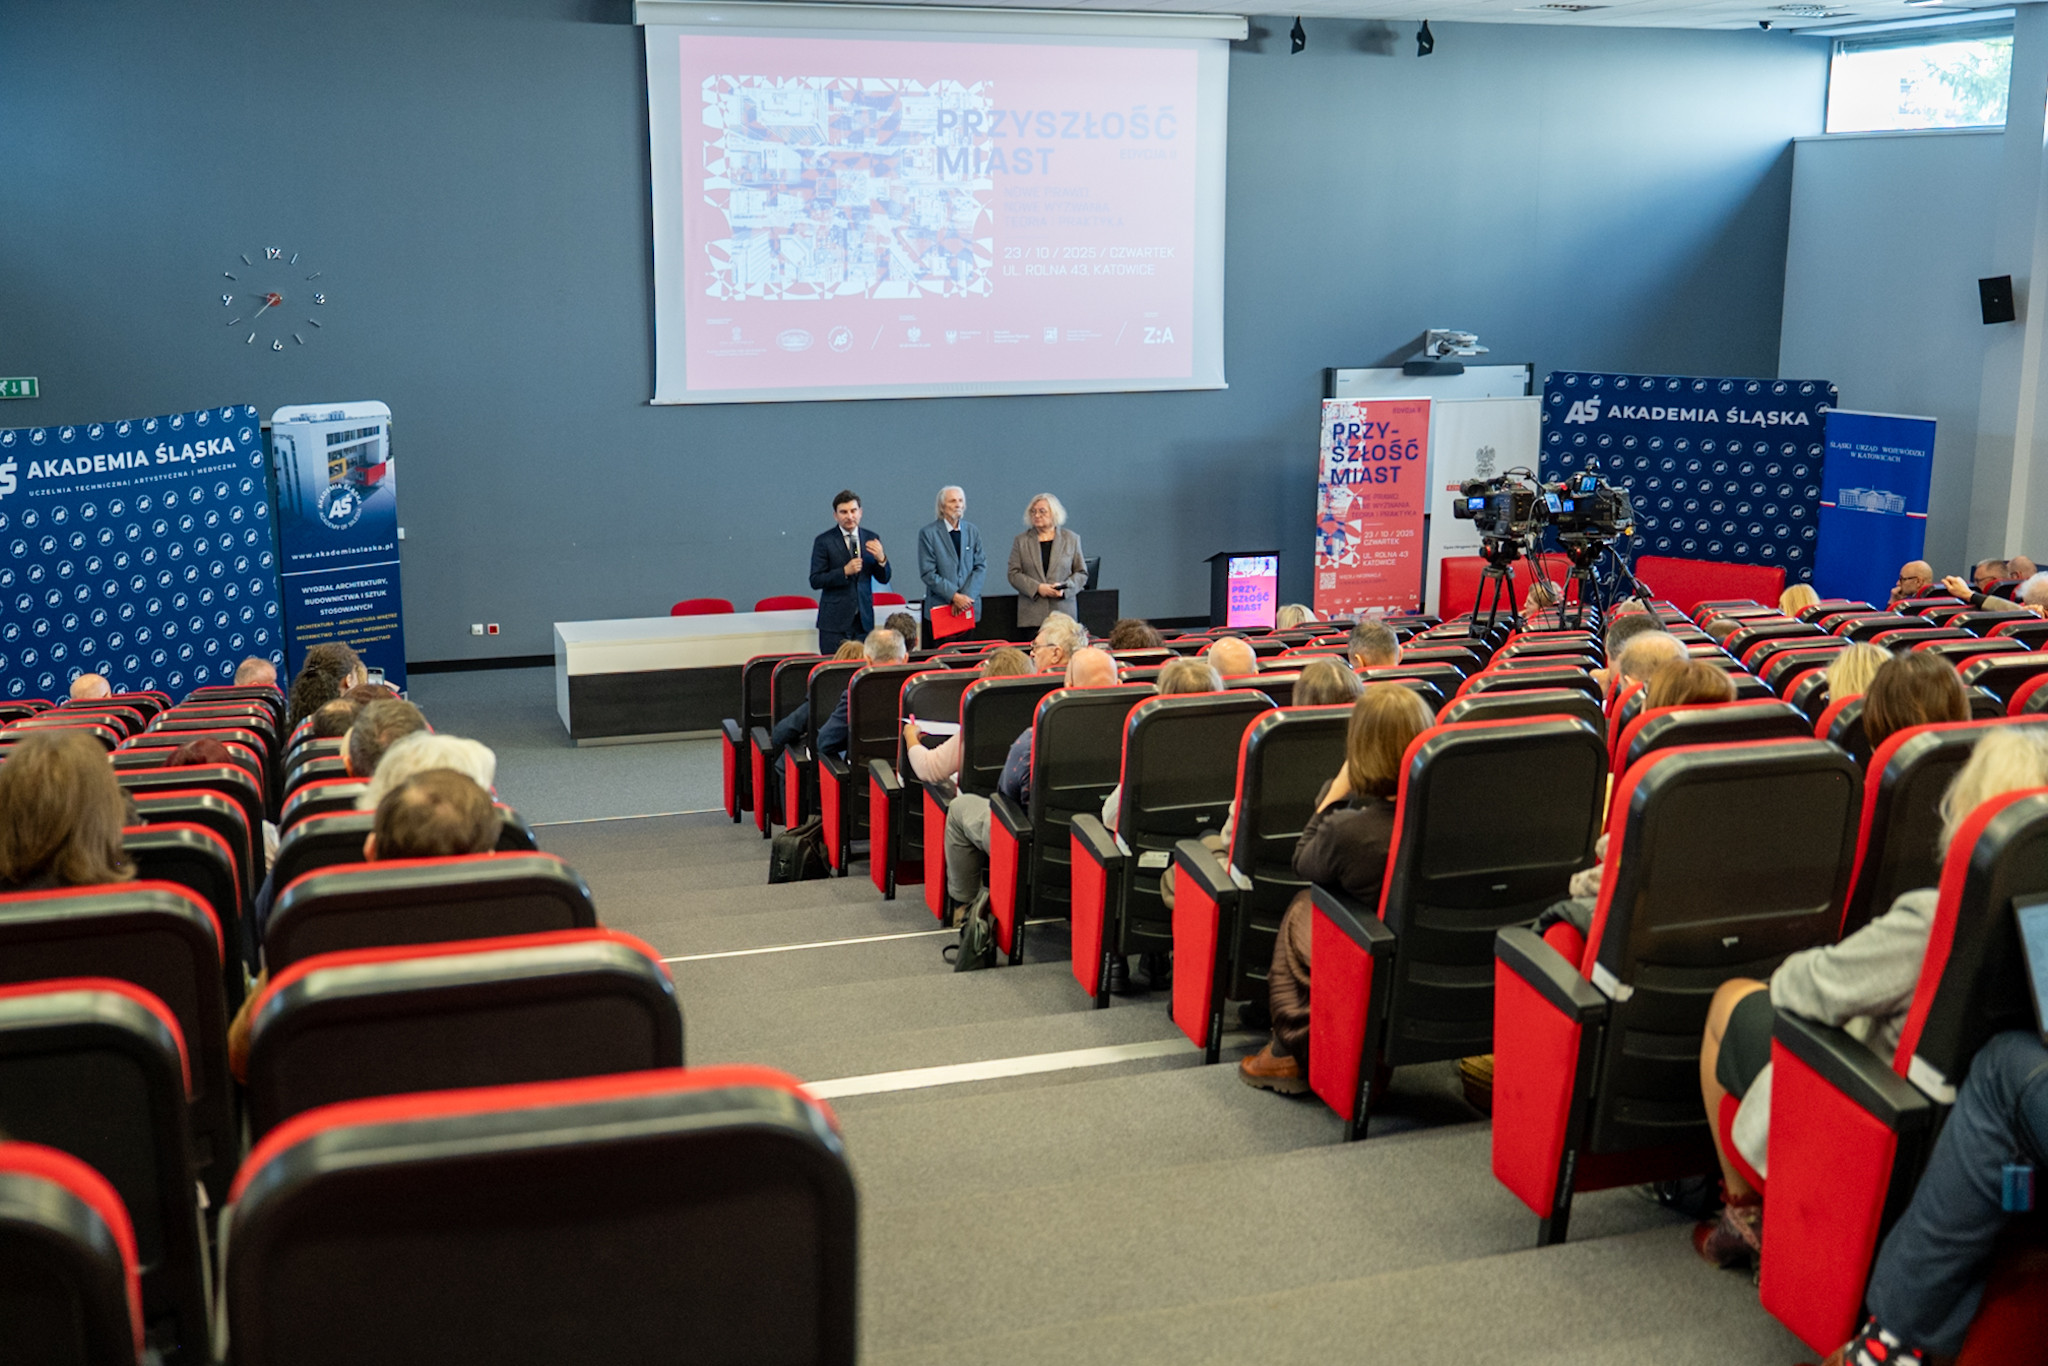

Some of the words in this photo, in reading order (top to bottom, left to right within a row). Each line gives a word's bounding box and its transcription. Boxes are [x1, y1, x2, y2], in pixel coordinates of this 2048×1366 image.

[937, 105, 1176, 140] PRZYSZŁOŚĆ
[937, 147, 1055, 175] MIAST
[264, 248, 281, 260] 12
[1004, 247, 1022, 258] 23
[1036, 248, 1049, 258] 10
[1064, 247, 1096, 258] 2025
[1110, 247, 1175, 258] CZWARTEK
[1025, 265, 1067, 276] ROLNA
[1094, 264, 1156, 276] KATOWICE
[1144, 326, 1174, 344] Z:A
[272, 339, 283, 350] 6
[1564, 394, 1602, 424] AŚ
[1608, 404, 1719, 423] AKADEMIA
[1726, 406, 1810, 428] ŚLĄSKA
[1333, 422, 1398, 440] PRZY-
[1332, 439, 1418, 462] SZŁOŚĆ
[1856, 442, 1878, 452] URZĄD
[26, 450, 150, 480] AKADEMIA
[154, 436, 236, 464] ŚLĄSKA
[1858, 452, 1901, 462] KATOWICACH
[0, 456, 18, 500] Ś
[29, 487, 72, 496] UCZELNIA
[134, 471, 188, 485] ARTYSTYCZNA
[197, 462, 237, 474] MEDYCZNA
[1330, 466, 1402, 485] MIAST
[328, 494, 352, 519] AŚ
[291, 543, 393, 560] www.akademiaslaska.pl
[302, 584, 334, 594] WYDZIAŁ
[304, 594, 360, 606] BUDOWNICTWA
[364, 590, 386, 598] SZTUK
[320, 604, 373, 616] STOSOWANYCH
[1232, 604, 1262, 612] MIAST
